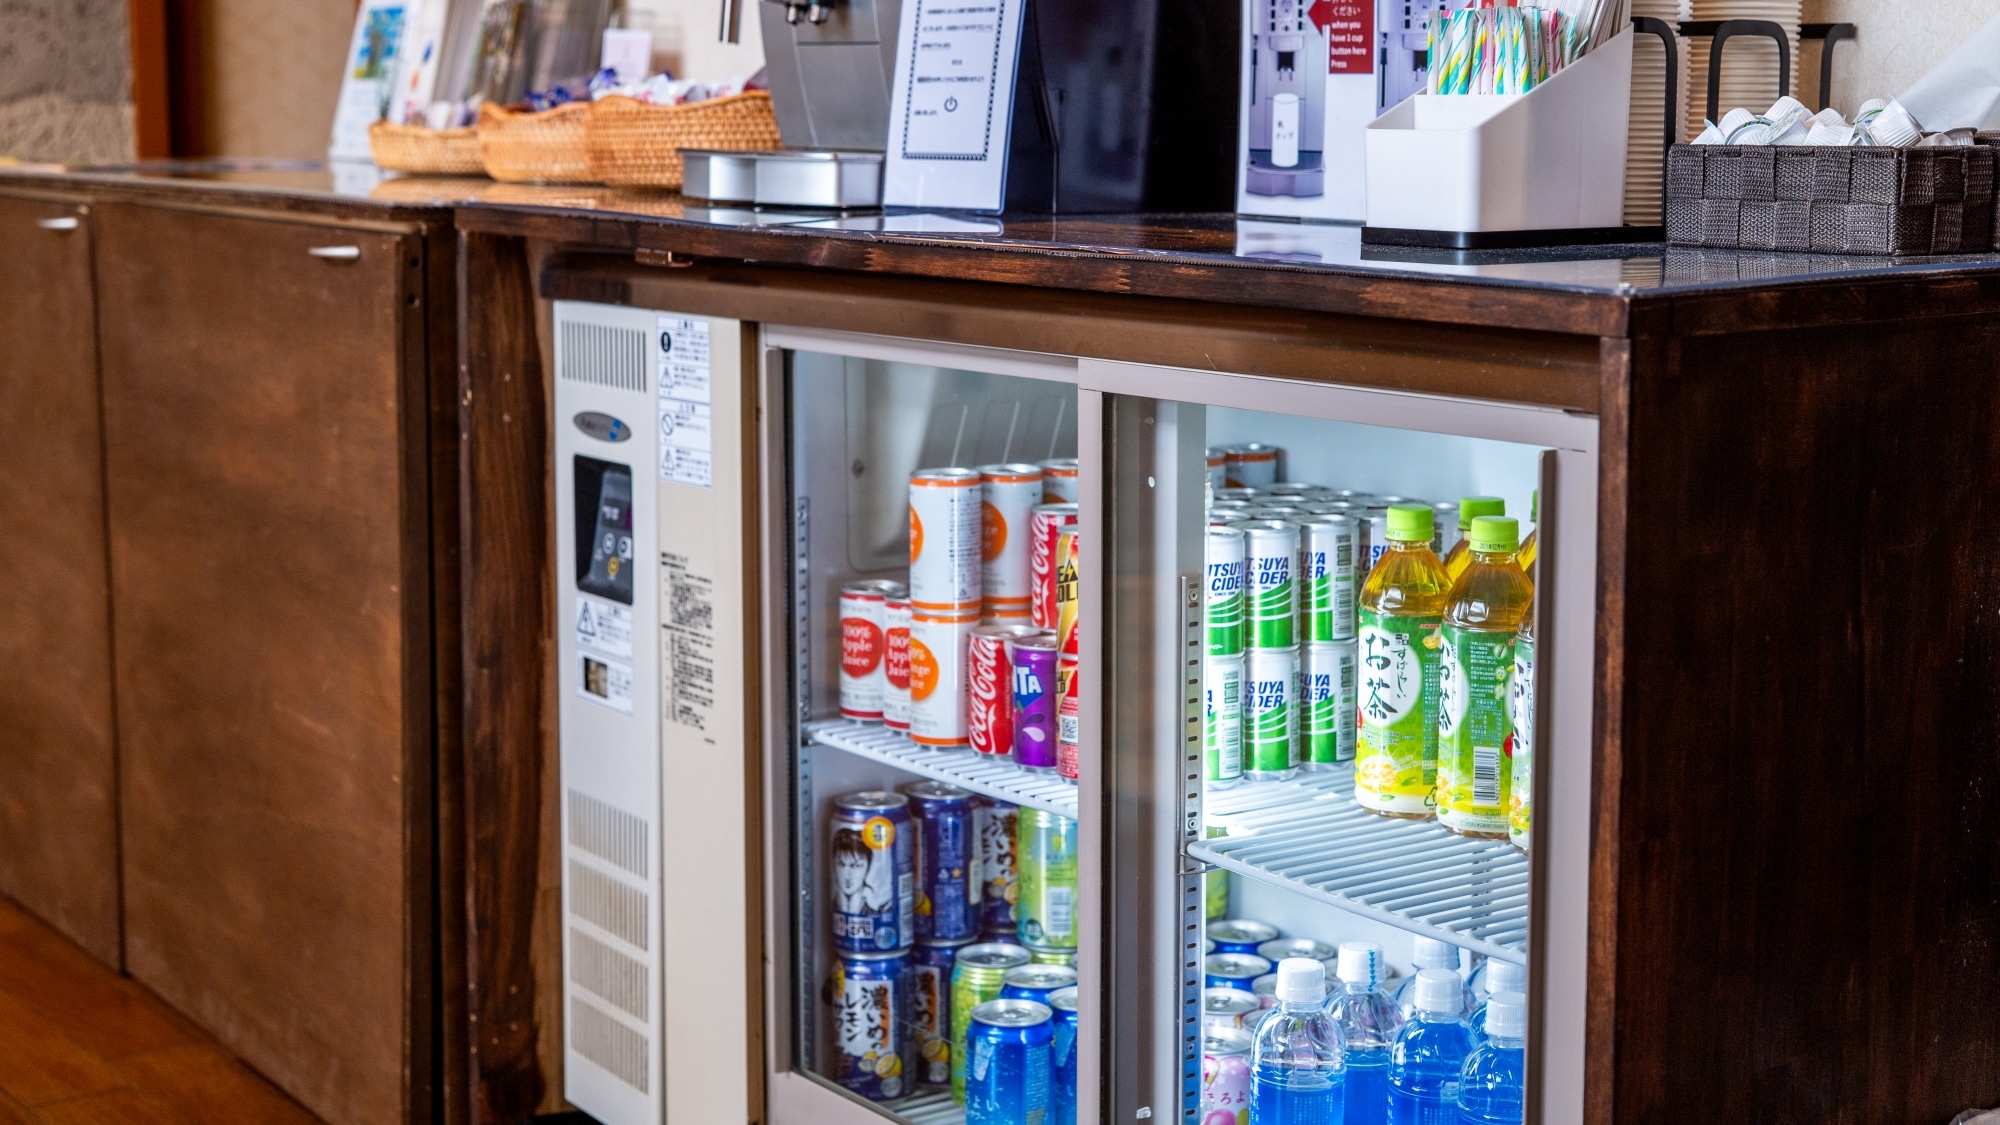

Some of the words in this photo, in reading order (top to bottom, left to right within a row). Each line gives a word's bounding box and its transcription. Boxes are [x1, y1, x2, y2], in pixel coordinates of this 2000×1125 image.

[1331, 20, 1348, 29] when
[1349, 22, 1361, 30] you
[1331, 33, 1346, 42] have
[1351, 35, 1363, 43] cup
[1331, 46, 1351, 55] button
[1352, 45, 1366, 55] here
[1331, 59, 1347, 68] Press
[1245, 571, 1288, 585] CDER
[1057, 584, 1078, 603] OL
[911, 663, 930, 677] nge
[1363, 633, 1398, 719] お茶
[1391, 647, 1408, 699] すばらしい
[846, 992, 860, 1042] レモン
